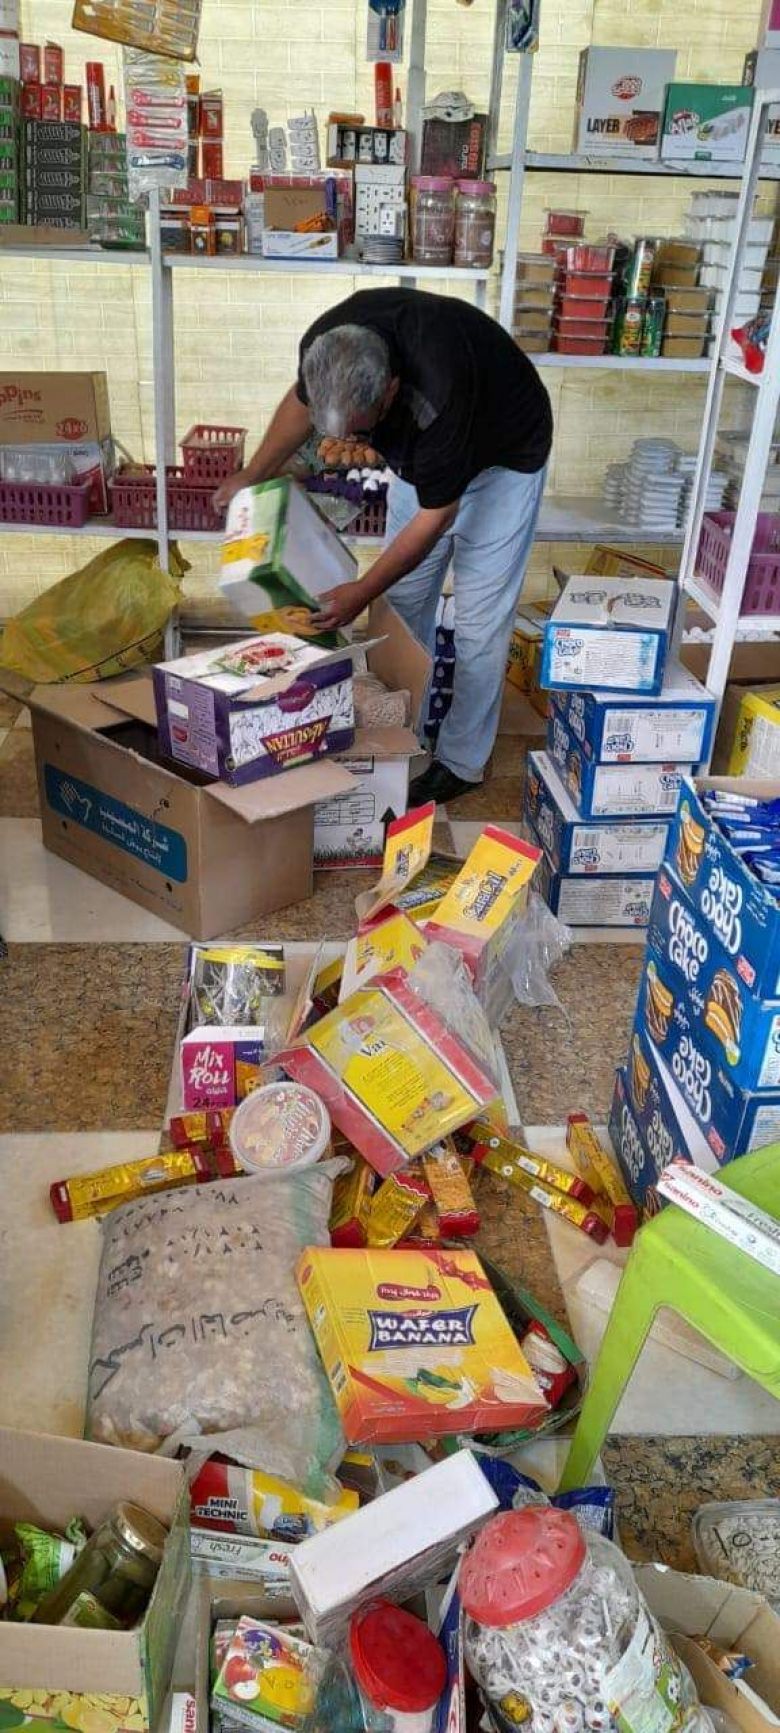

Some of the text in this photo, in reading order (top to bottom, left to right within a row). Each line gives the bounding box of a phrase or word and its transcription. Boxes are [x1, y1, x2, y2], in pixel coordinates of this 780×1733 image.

[587, 118, 620, 133] LAYER
[708, 867, 743, 917] Cake
[669, 900, 708, 963] Choco
[700, 888, 742, 955] Choco
[669, 937, 700, 981] Cake
[193, 1044, 223, 1073] Mix
[678, 1035, 711, 1088] Cake
[672, 1052, 711, 1122] Choco
[375, 1317, 465, 1332] WAFER
[377, 1330, 468, 1343] BANANA
[197, 1507, 247, 1521] TECHNIC
[209, 1498, 238, 1509] MINI
[209, 1542, 242, 1558] Fresh
